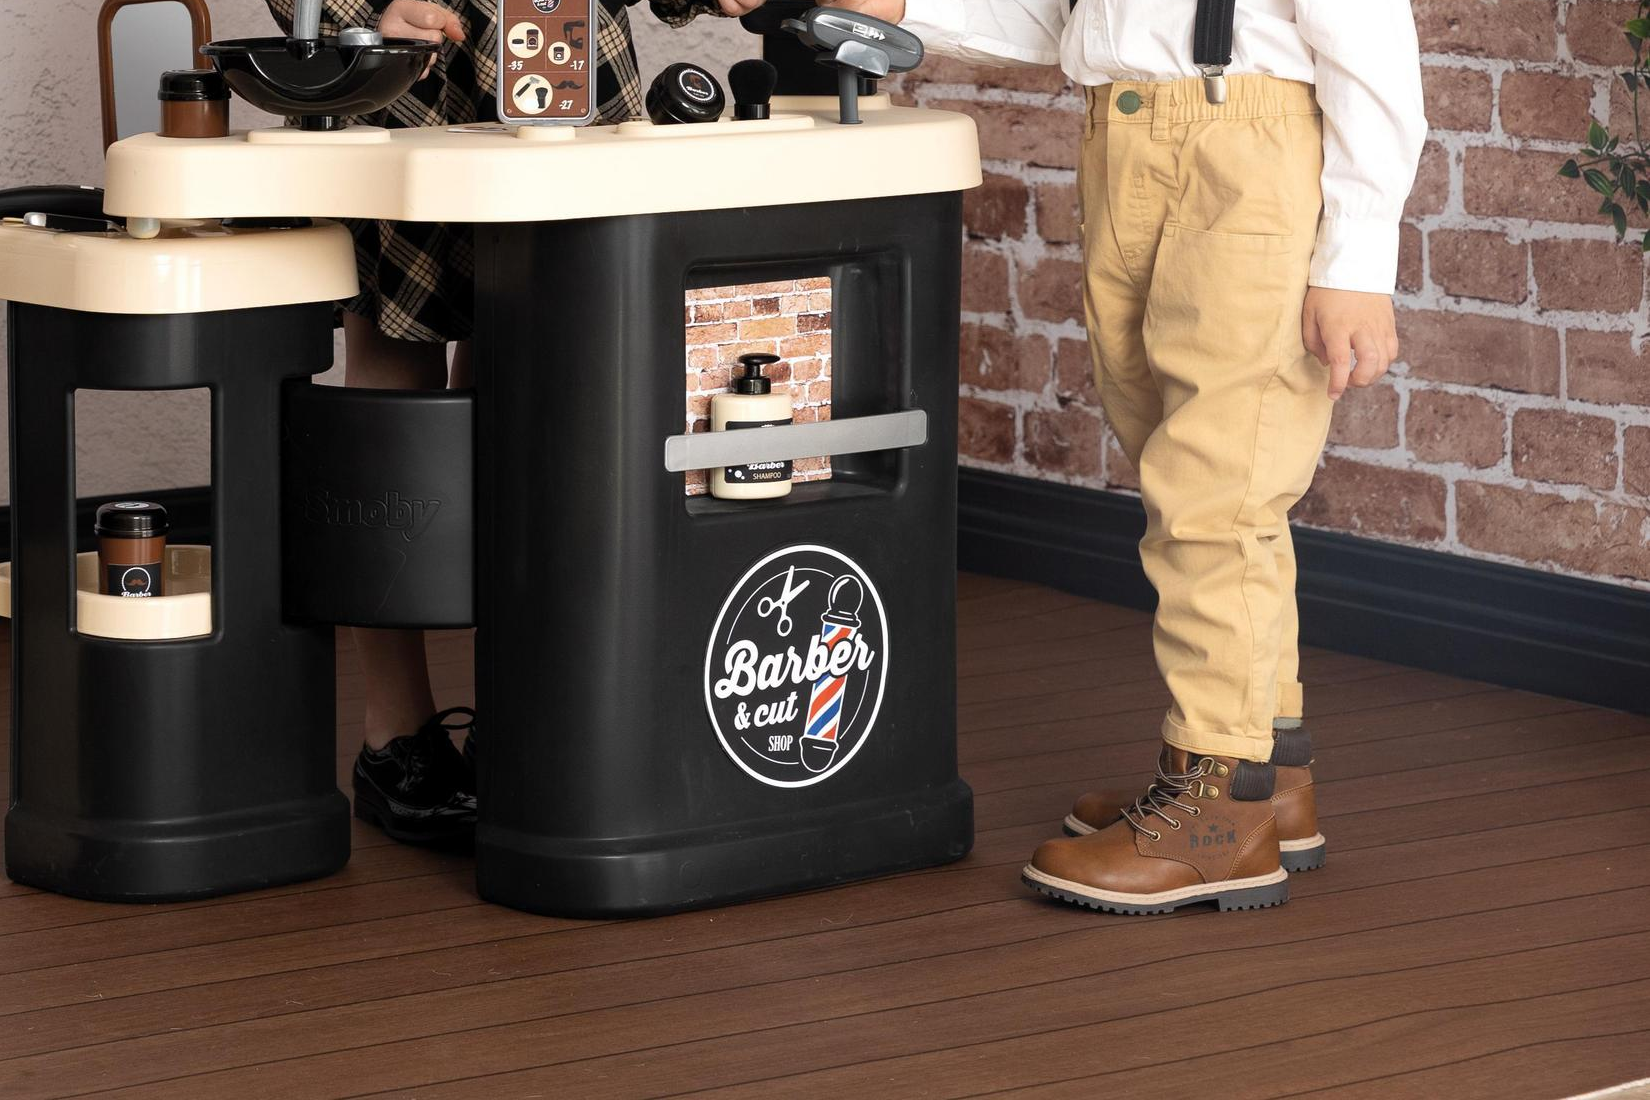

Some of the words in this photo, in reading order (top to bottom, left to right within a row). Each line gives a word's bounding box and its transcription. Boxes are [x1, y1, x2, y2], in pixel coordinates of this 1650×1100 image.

[752, 471, 781, 480] SHAMPOO
[303, 490, 441, 543] Smoby
[714, 633, 875, 700] Barber
[733, 702, 751, 731] &
[753, 690, 799, 727] cut
[768, 733, 794, 753] SHOP
